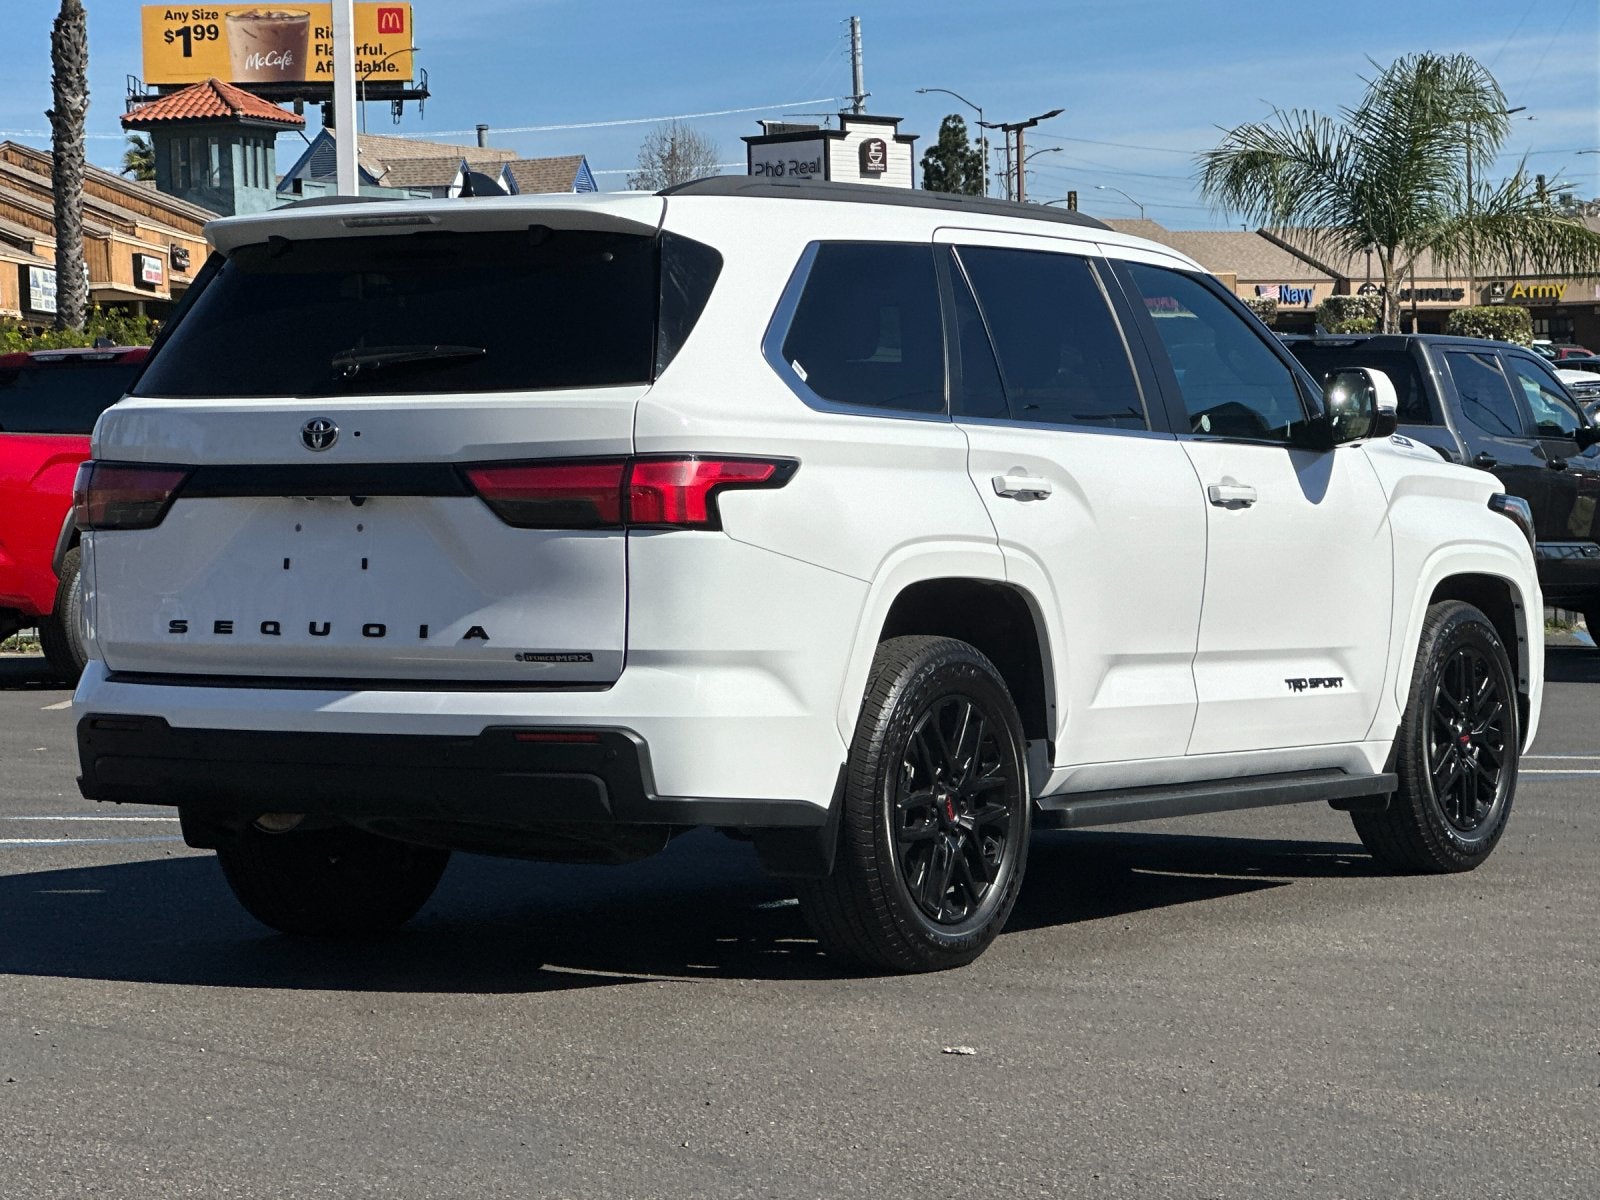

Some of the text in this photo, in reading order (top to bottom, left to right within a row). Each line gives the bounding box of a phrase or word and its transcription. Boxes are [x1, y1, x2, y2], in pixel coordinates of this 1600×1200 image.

[164, 9, 219, 23] Any Size
[315, 43, 387, 56] Flarful.
[245, 50, 294, 70] McCafé
[789, 156, 822, 175] Real
[1281, 285, 1315, 305] Navy
[1512, 282, 1567, 299] Army
[169, 620, 490, 640] SEQUOIA
[1285, 677, 1344, 693] TRD SPORT
